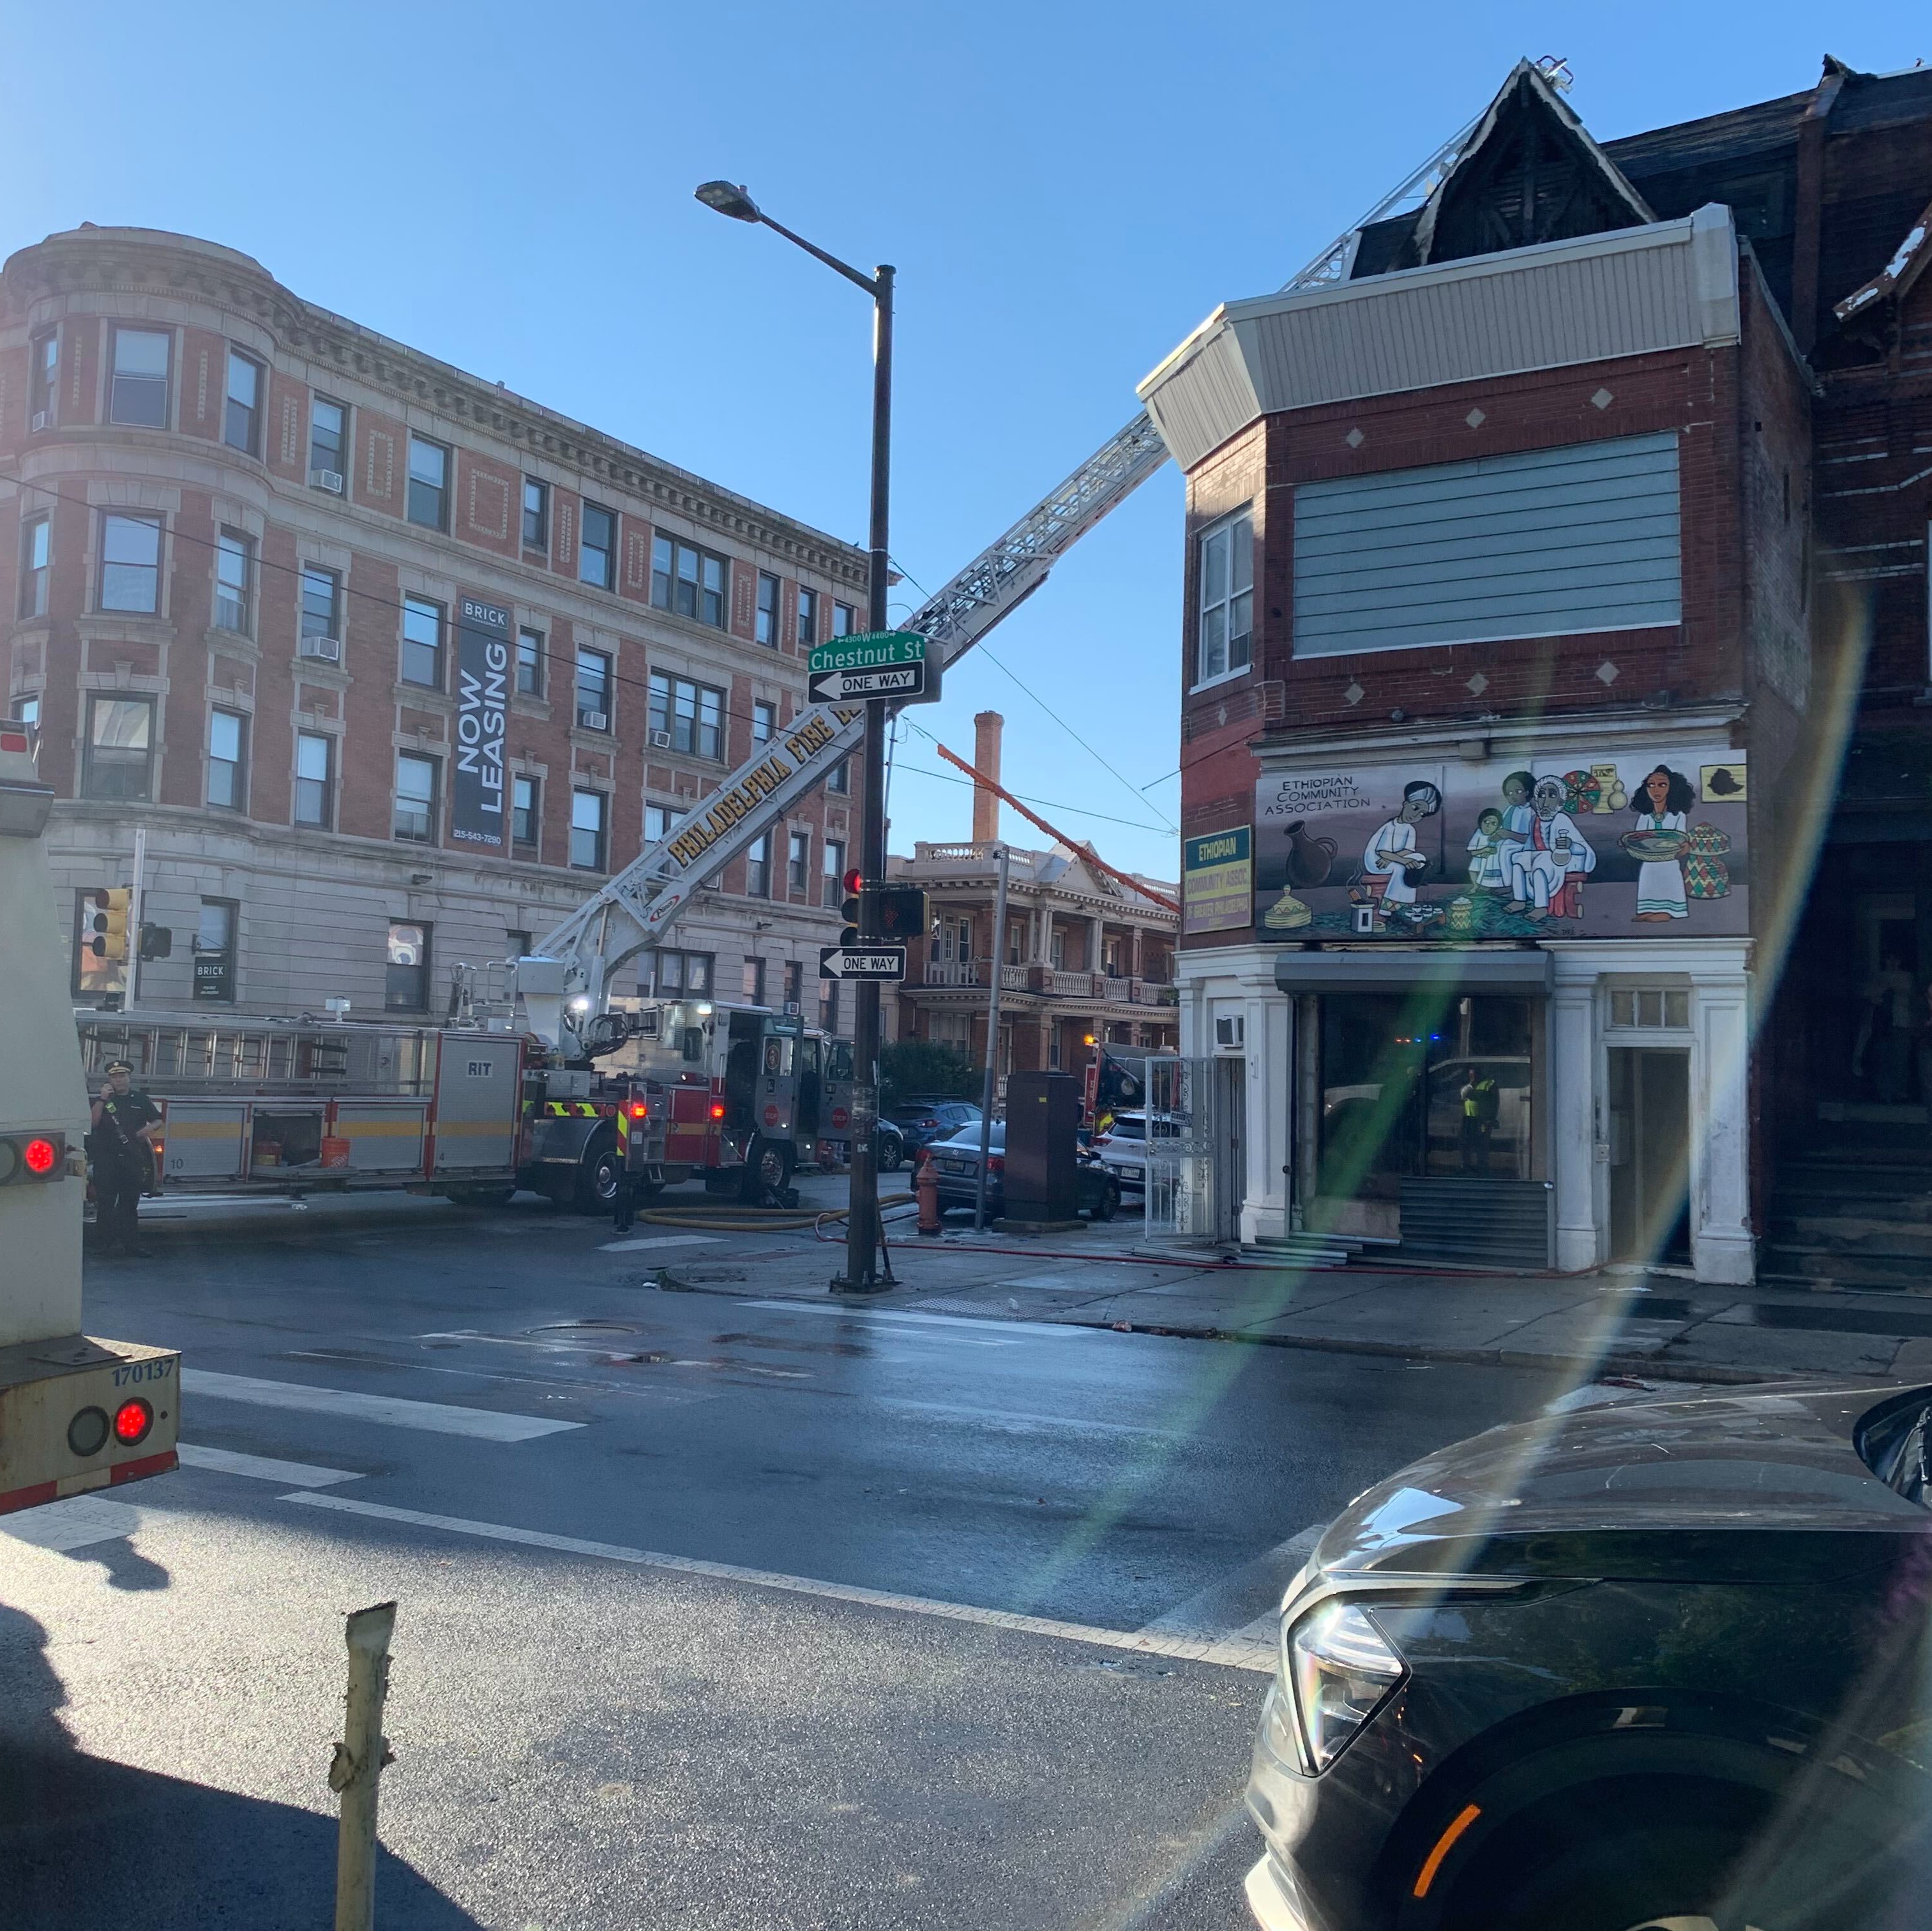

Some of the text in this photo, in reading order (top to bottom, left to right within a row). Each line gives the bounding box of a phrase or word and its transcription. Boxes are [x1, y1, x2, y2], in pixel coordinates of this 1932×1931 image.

[465, 603, 505, 625] BRICK
[862, 632, 872, 642] W
[811, 640, 921, 670] Chestnut St
[843, 672, 910, 692] ONE WAY
[458, 669, 482, 773] NOW
[481, 642, 507, 814] LEASING
[668, 756, 792, 869] PHILADELPHIA
[785, 715, 835, 765] FIRE
[1282, 775, 1353, 791] ETHIOPIAN
[1277, 786, 1359, 803] COMMUNITY
[1265, 798, 1371, 815] ASSOCIATION
[1198, 837, 1237, 862] ETHIOPIAN
[1188, 872, 1223, 893] COMMUNITY
[197, 966, 223, 976] BRICK
[843, 957, 895, 970] ONE WAY
[468, 1062, 492, 1076] RIT
[171, 1158, 184, 1170] 10
[439, 1153, 445, 1161] 4
[112, 1358, 174, 1387] 170137
